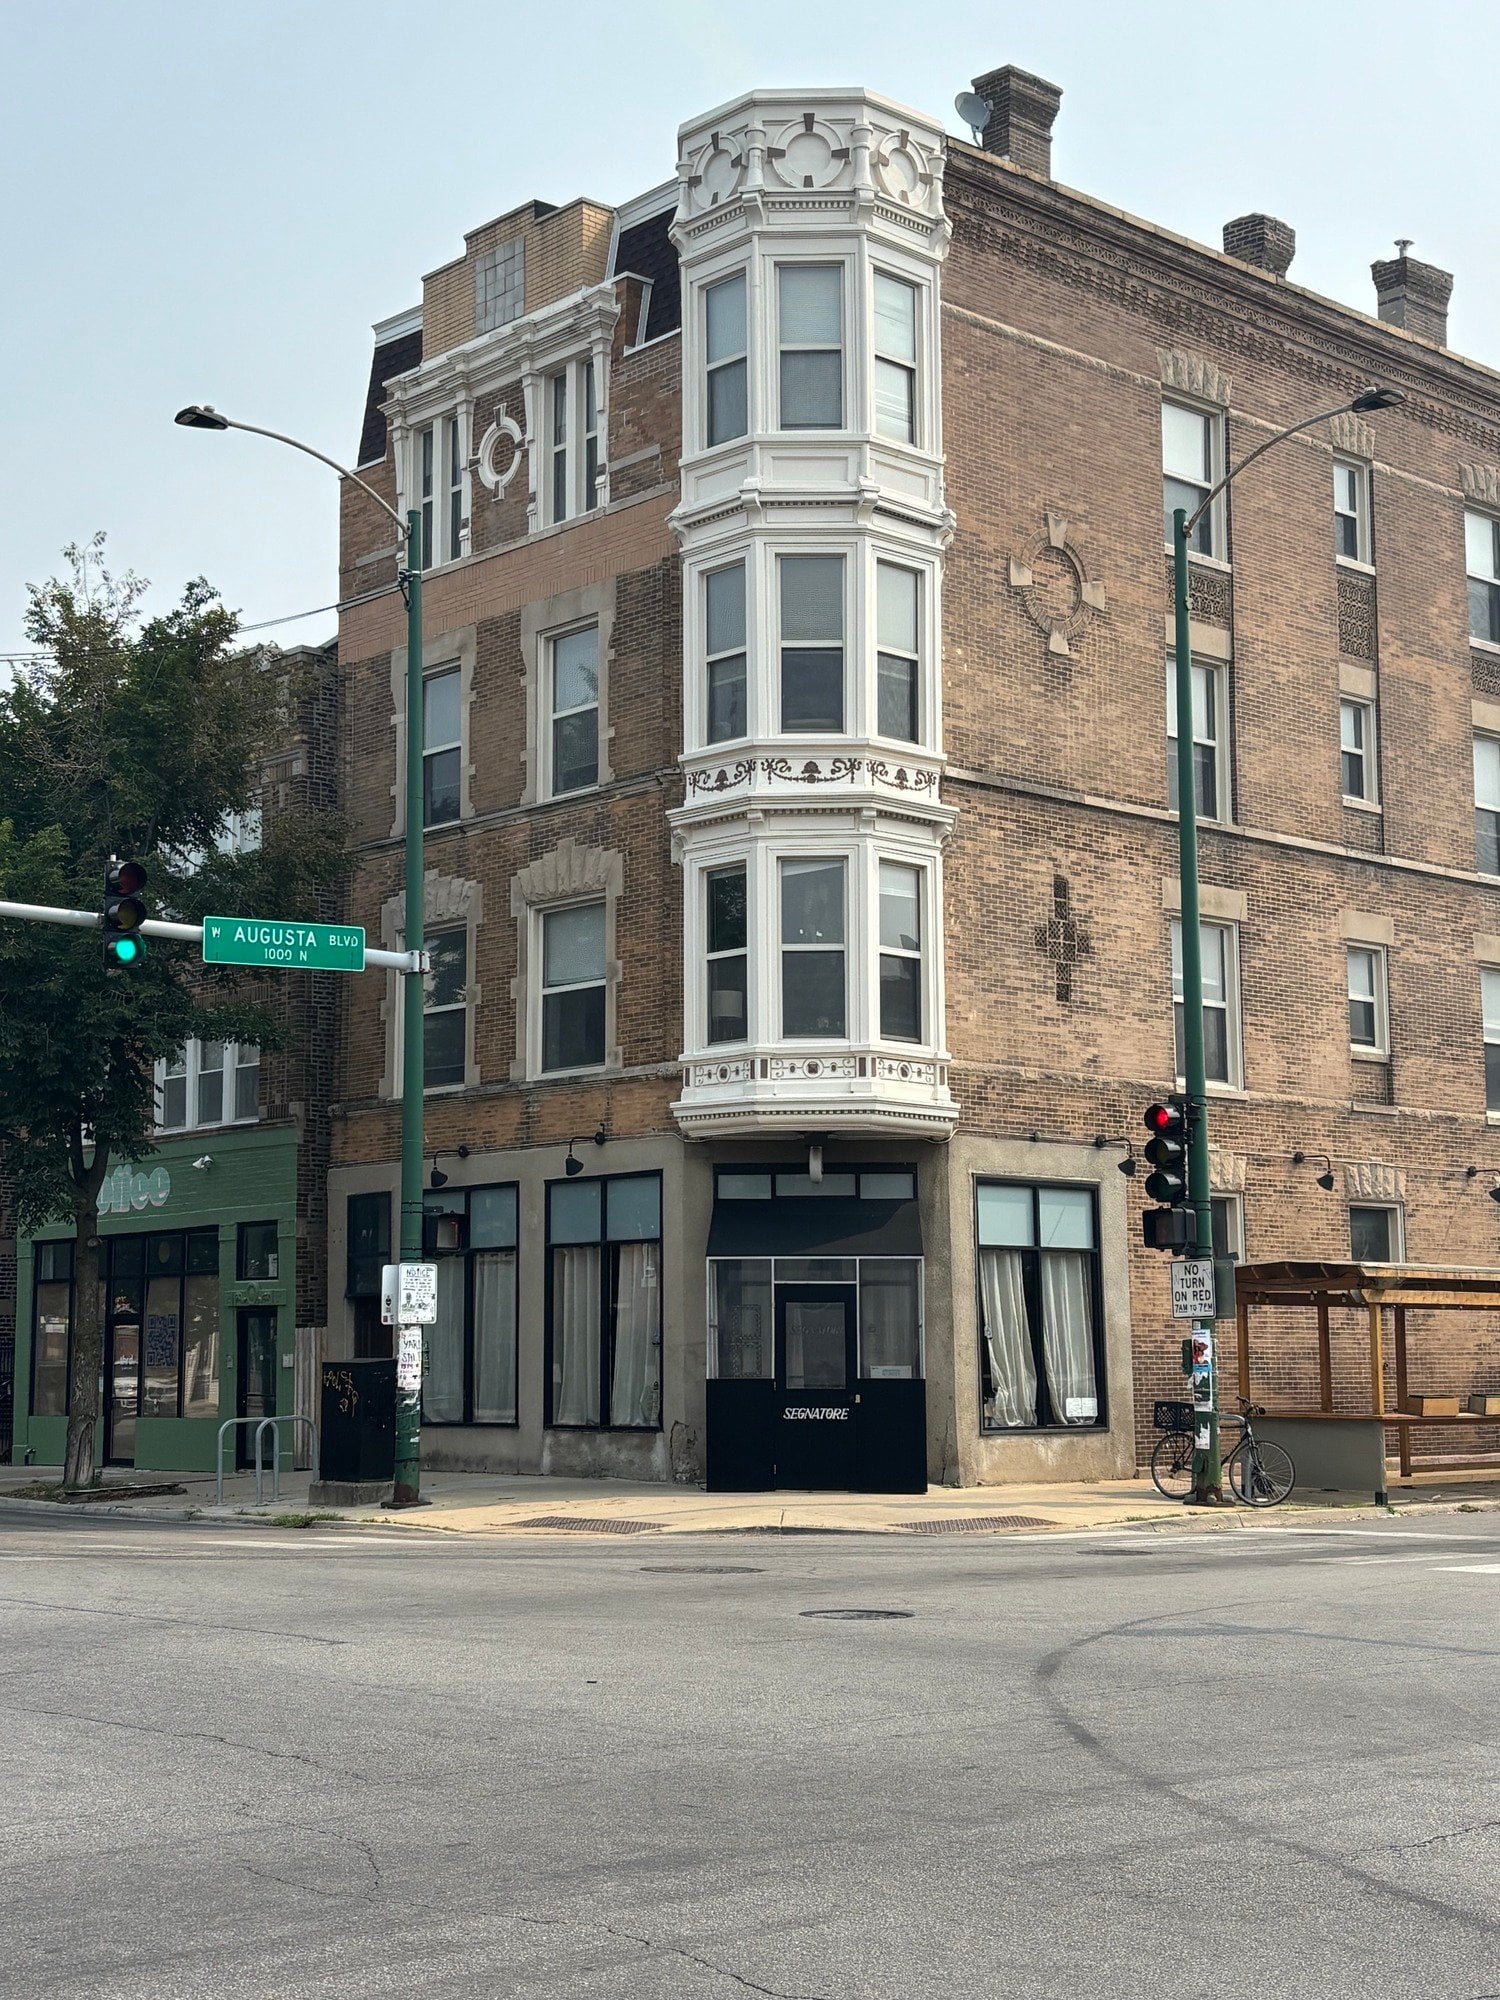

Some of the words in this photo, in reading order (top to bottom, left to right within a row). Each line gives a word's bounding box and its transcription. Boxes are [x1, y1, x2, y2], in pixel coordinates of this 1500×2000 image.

[211, 926, 221, 938] W
[233, 926, 317, 947] AUGUSTA
[329, 935, 359, 947] BLVD
[264, 948, 293, 961] 1000
[300, 950, 308, 962] N
[406, 1267, 431, 1277] NOTICE
[1184, 1264, 1199, 1276] NO
[1180, 1277, 1205, 1289] TURN
[1174, 1291, 1187, 1302] ON
[1192, 1289, 1211, 1301] RED
[1174, 1303, 1188, 1313] 7AM
[1198, 1302, 1213, 1312] 7PM
[782, 1407, 850, 1420] SEGNATORE
